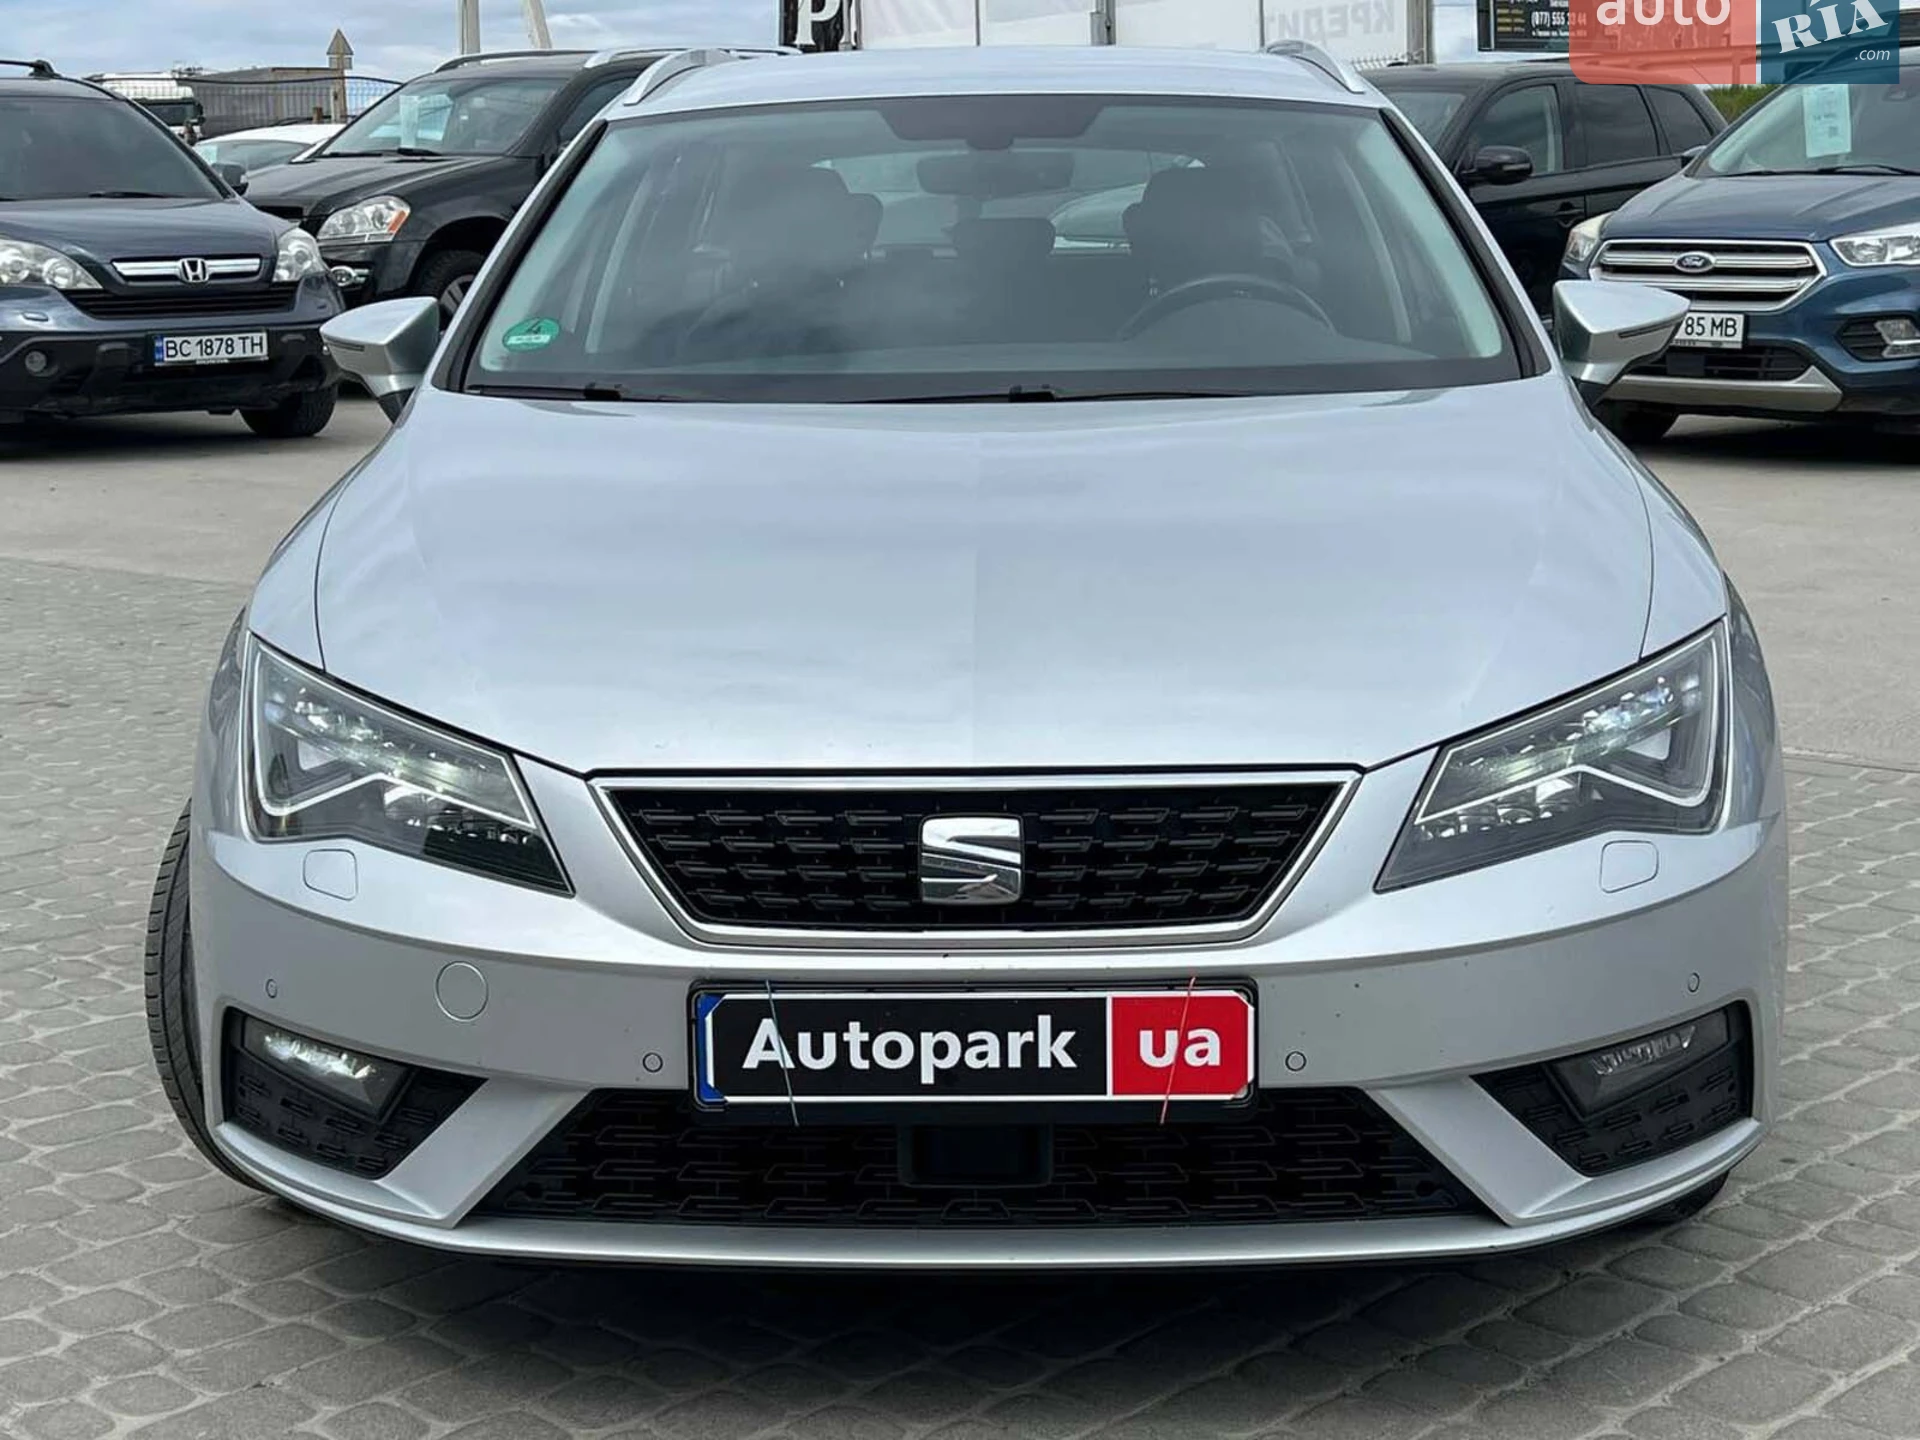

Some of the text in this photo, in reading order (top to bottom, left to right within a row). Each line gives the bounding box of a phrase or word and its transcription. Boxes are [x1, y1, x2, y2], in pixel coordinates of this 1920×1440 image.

[1684, 316, 1737, 337] 85 MB
[165, 335, 263, 358] BC 1878 TH
[741, 1014, 1221, 1085] Autopark ua
